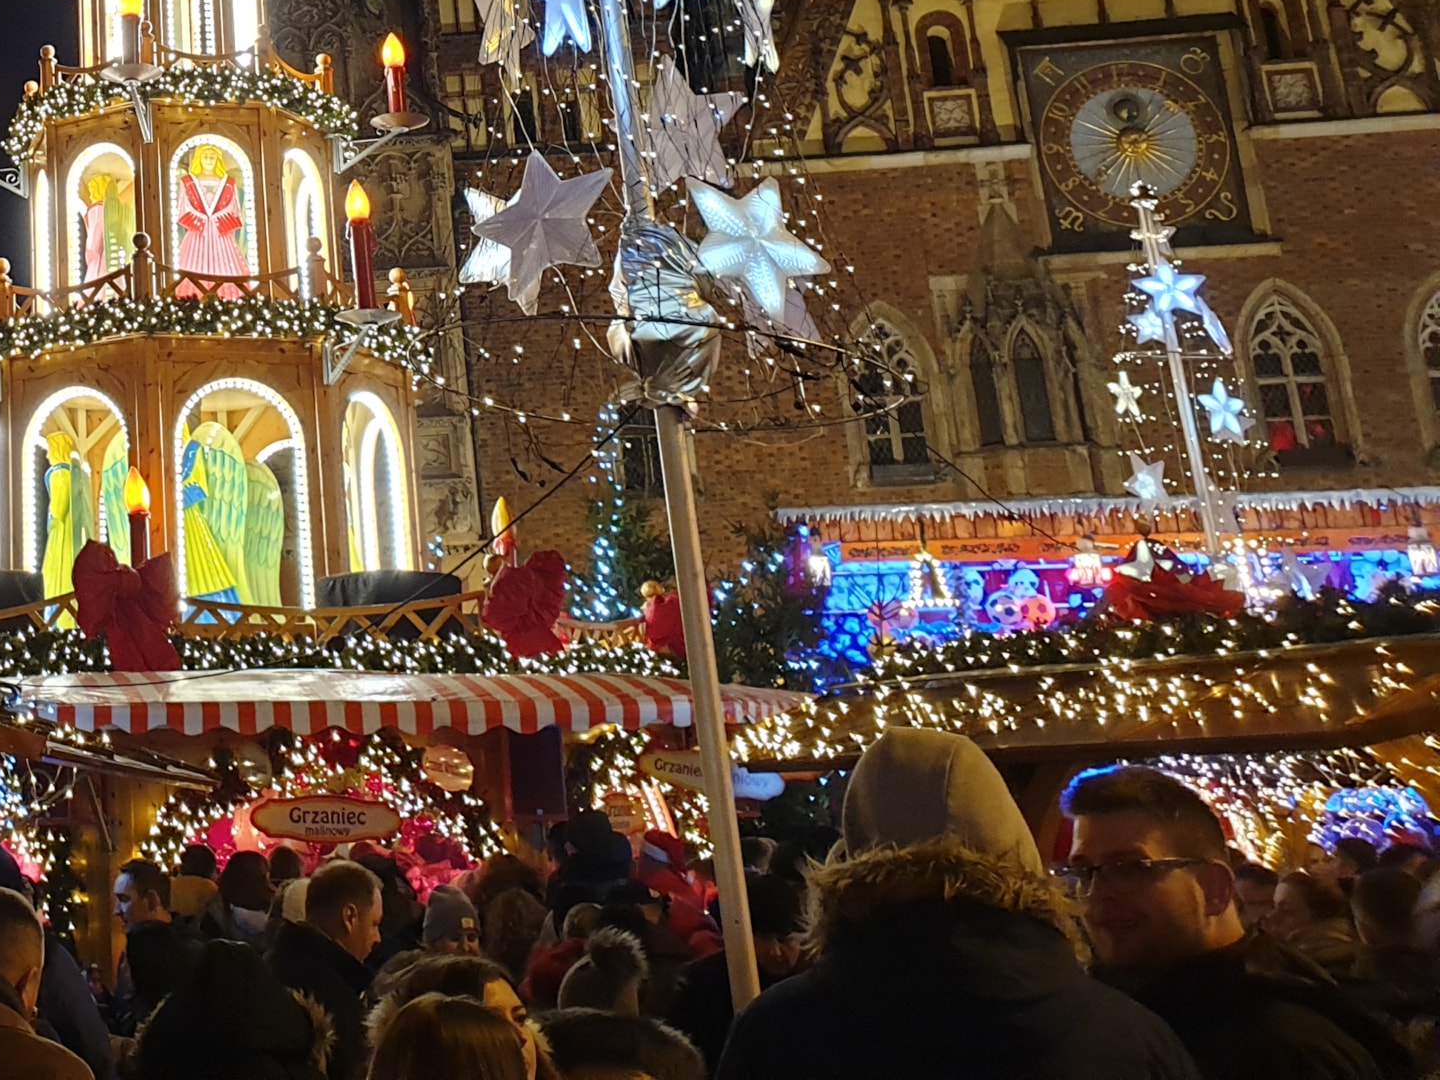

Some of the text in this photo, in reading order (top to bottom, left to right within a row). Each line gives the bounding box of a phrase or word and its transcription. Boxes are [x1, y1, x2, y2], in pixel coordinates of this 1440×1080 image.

[1048, 102, 1071, 120] 10
[1044, 143, 1065, 156] 9
[1201, 167, 1220, 181] 4
[1060, 176, 1080, 191] 8
[653, 757, 703, 777] Grzanie
[289, 806, 367, 825] Grzaniec
[304, 826, 351, 837] malinowy
